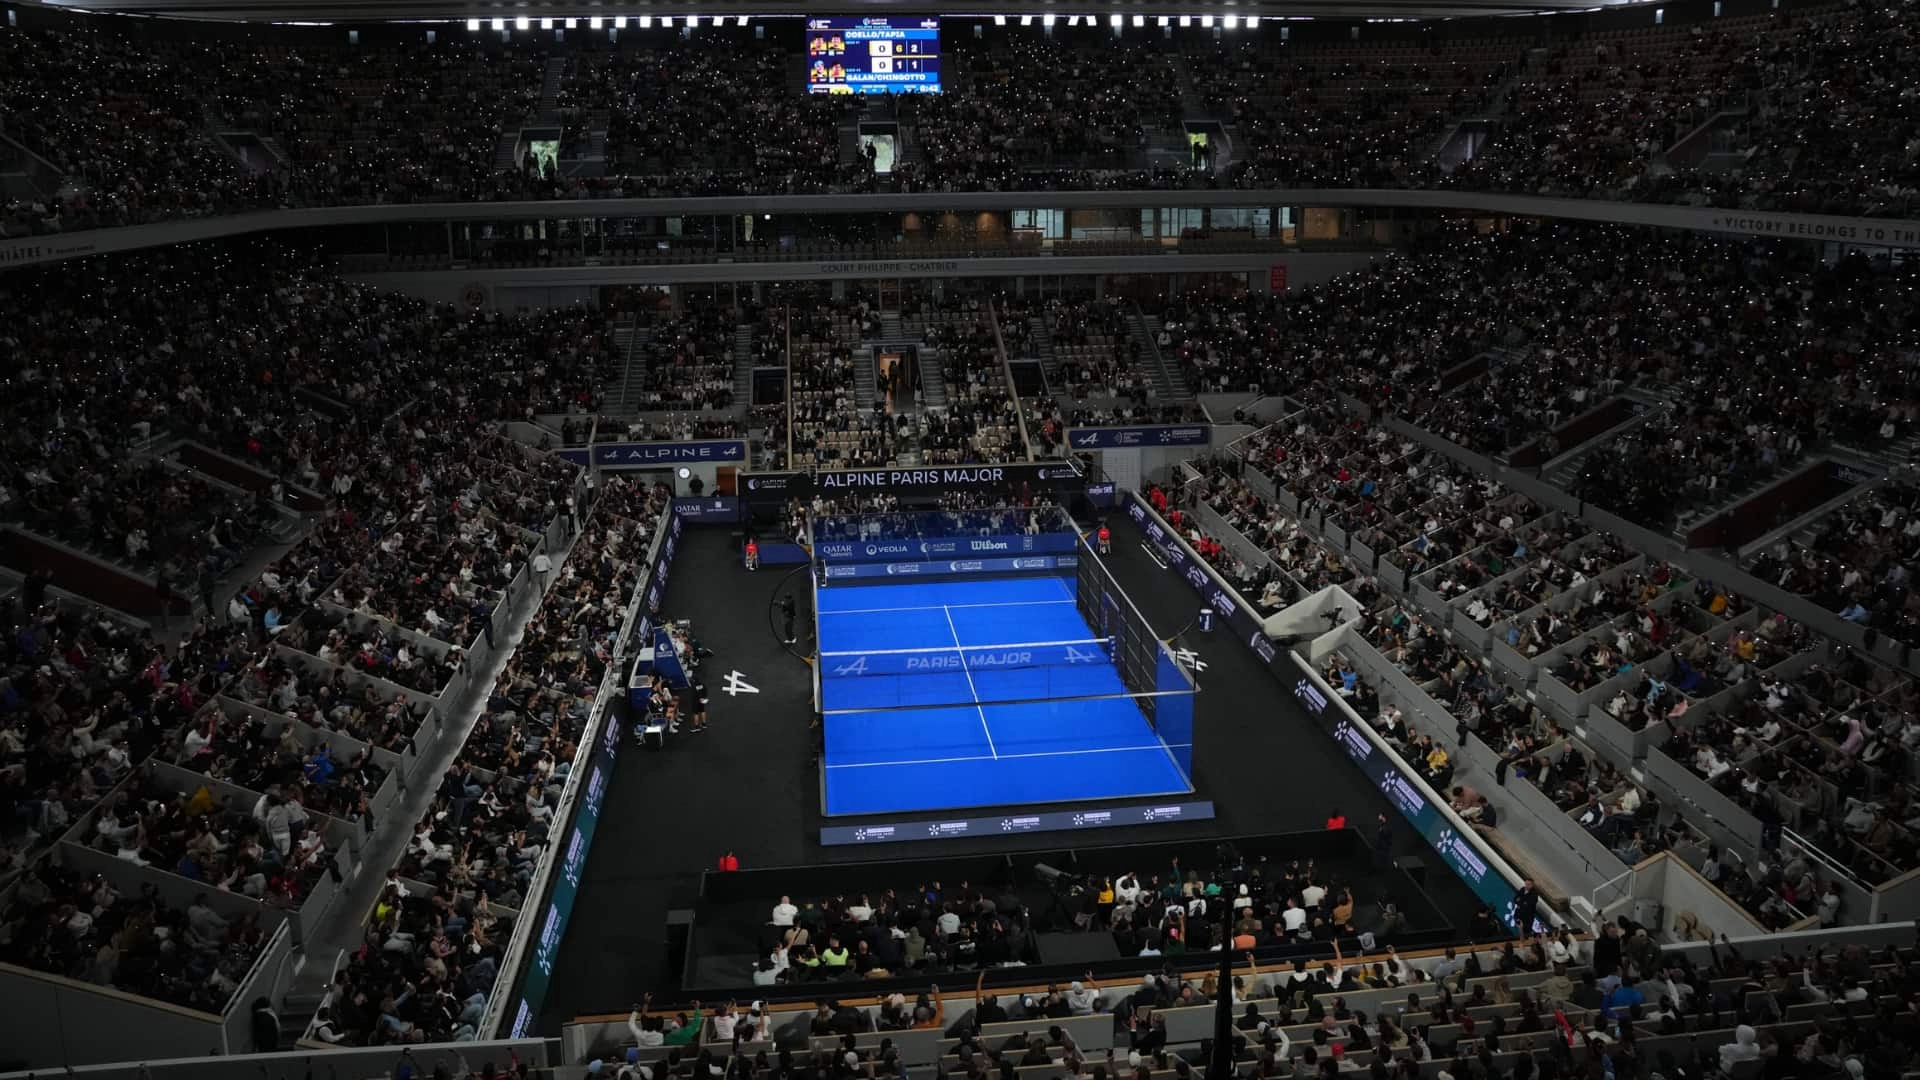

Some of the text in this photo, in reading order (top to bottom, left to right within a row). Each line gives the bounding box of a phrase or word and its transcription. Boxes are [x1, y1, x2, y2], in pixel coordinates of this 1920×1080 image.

[879, 45, 886, 53] 0
[897, 61, 902, 69] 1
[912, 61, 917, 69] 1
[1724, 217, 1782, 233] VICTORY
[1788, 223, 1857, 238] BELONGS
[1865, 228, 1885, 241] TO
[820, 262, 957, 273] COURT PHILIPPE CHATRIER
[629, 448, 711, 458] ALPINE
[824, 468, 1003, 487] ALPINE PARIS MAJOR
[675, 504, 701, 513] QATAR
[823, 544, 852, 554] QATAR
[878, 545, 908, 553] VEOLIA
[971, 539, 1008, 551] Wilson
[906, 652, 1032, 670] PARIS MAJOR
